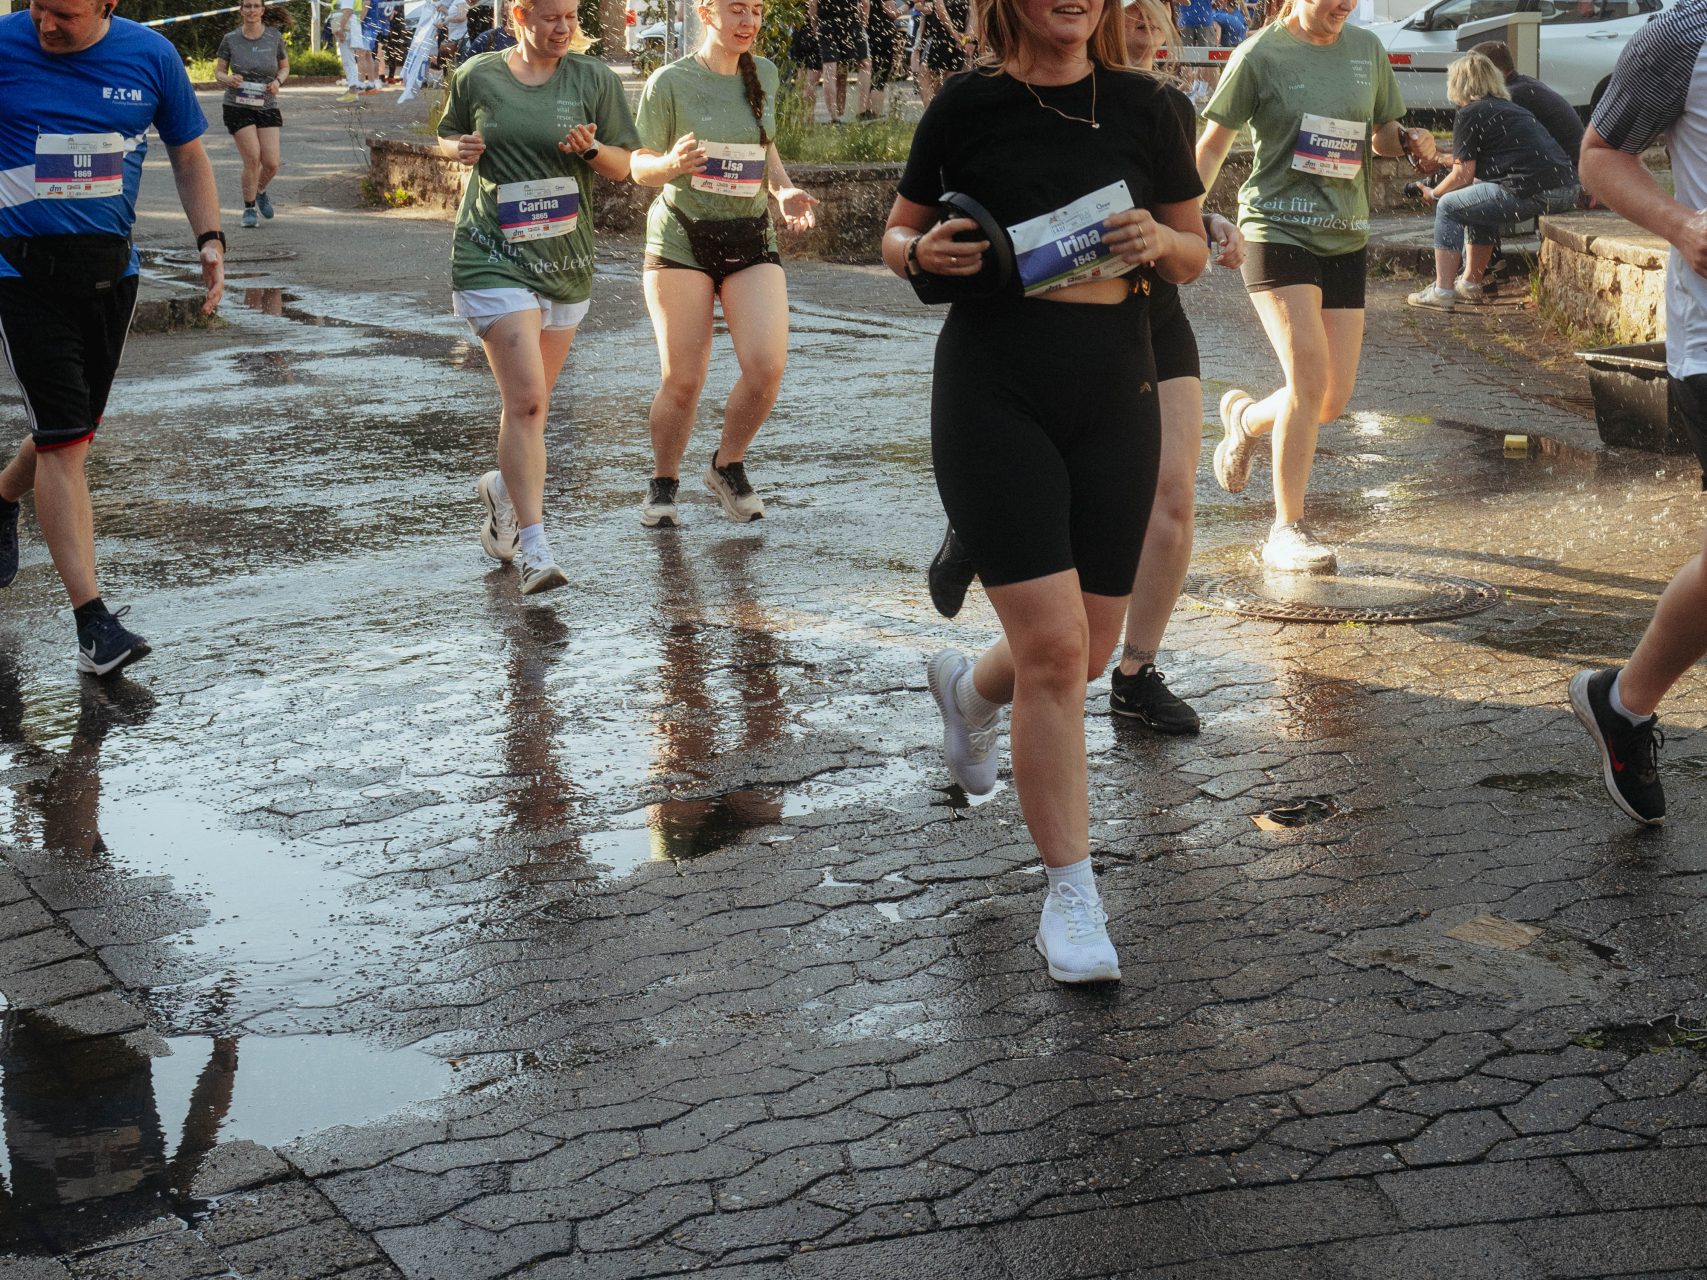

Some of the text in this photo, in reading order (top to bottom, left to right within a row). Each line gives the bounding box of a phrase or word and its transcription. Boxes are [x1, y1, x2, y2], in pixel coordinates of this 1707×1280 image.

[103, 87, 142, 100] EATON
[1309, 133, 1358, 152] Franziska
[73, 154, 92, 168] Uli
[721, 159, 744, 172] Lisa
[73, 170, 92, 178] 1869
[518, 199, 559, 213] Carina
[1252, 196, 1317, 213] Zeit für
[1270, 212, 1348, 231] gesundes
[1056, 229, 1101, 258] Irina
[1072, 250, 1097, 267] 1543
